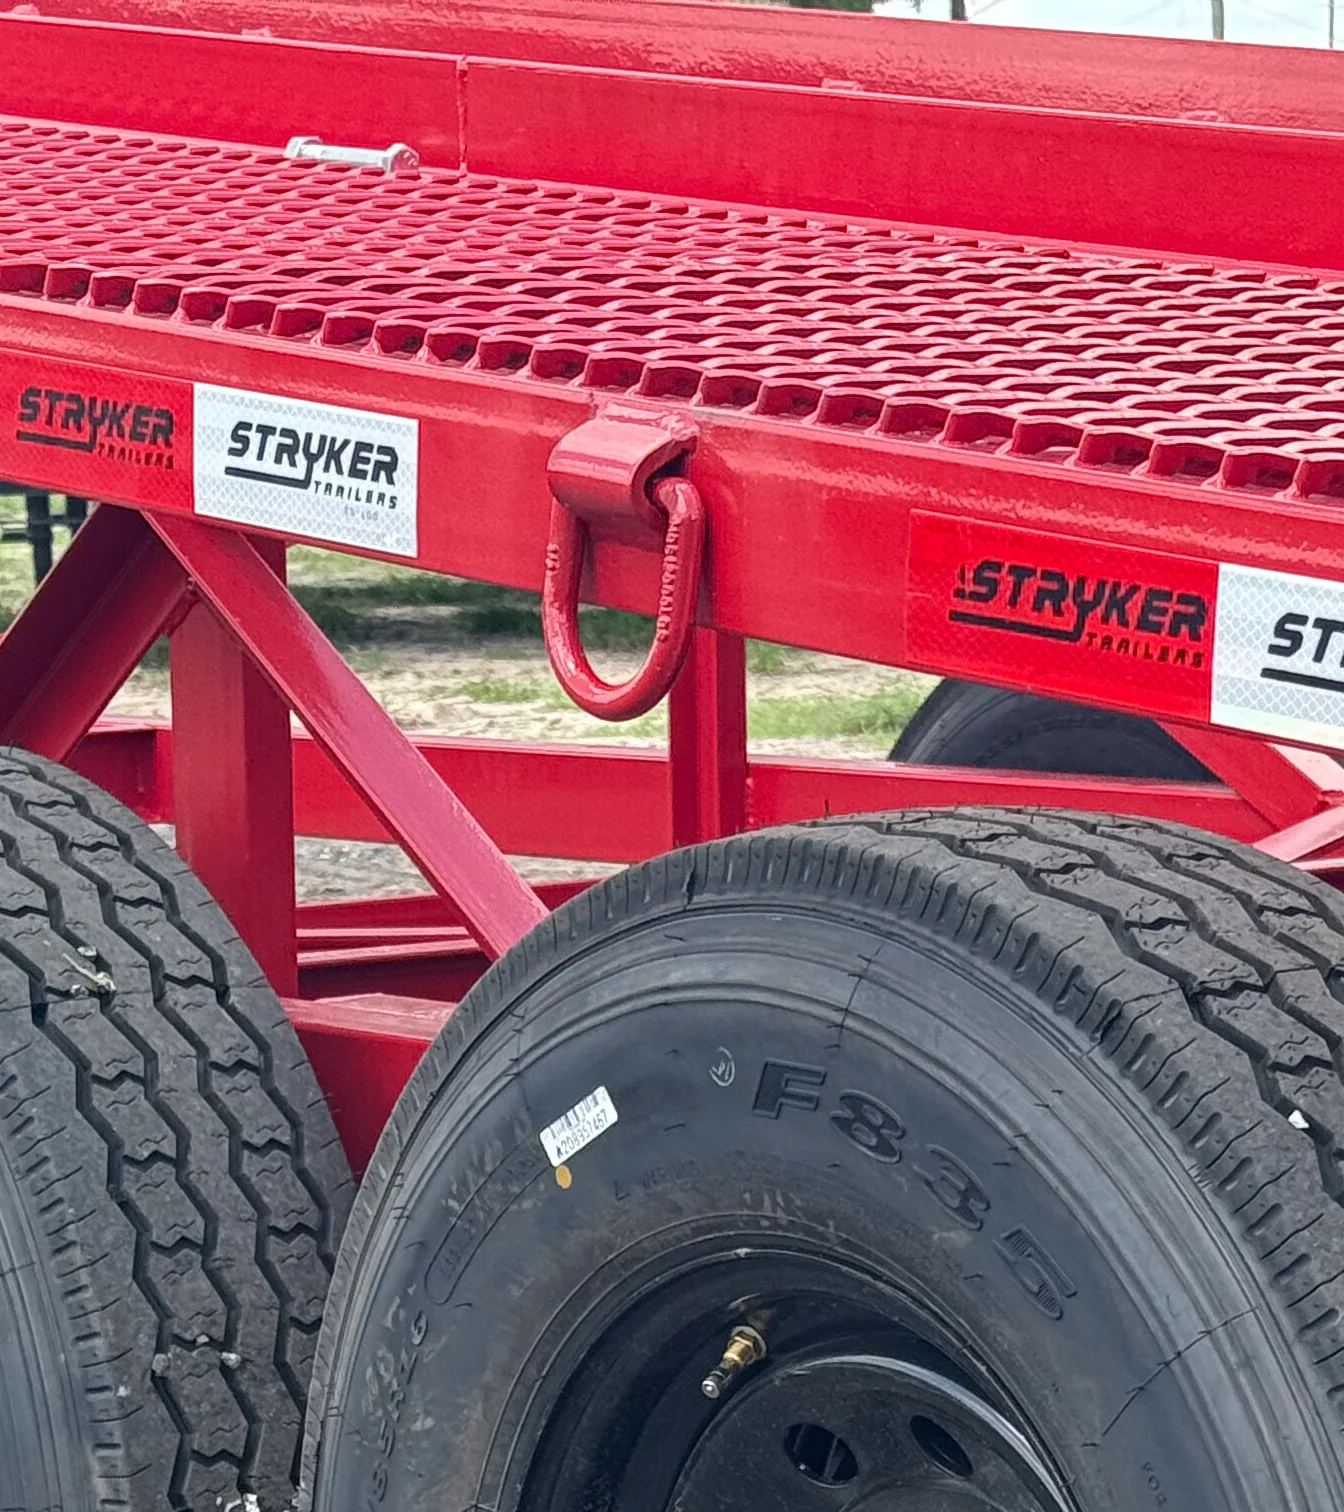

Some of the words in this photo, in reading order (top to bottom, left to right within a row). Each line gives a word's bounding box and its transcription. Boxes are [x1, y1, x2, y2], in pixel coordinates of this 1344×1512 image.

[16, 385, 174, 454] STRYKER
[98, 442, 174, 469] TRAILERS
[225, 421, 399, 490] STRYKER
[314, 480, 397, 510] TRAILERS
[949, 560, 1208, 643] STRYKER
[1086, 632, 1204, 668] TRAILERS
[752, 1057, 1077, 1320] F835
